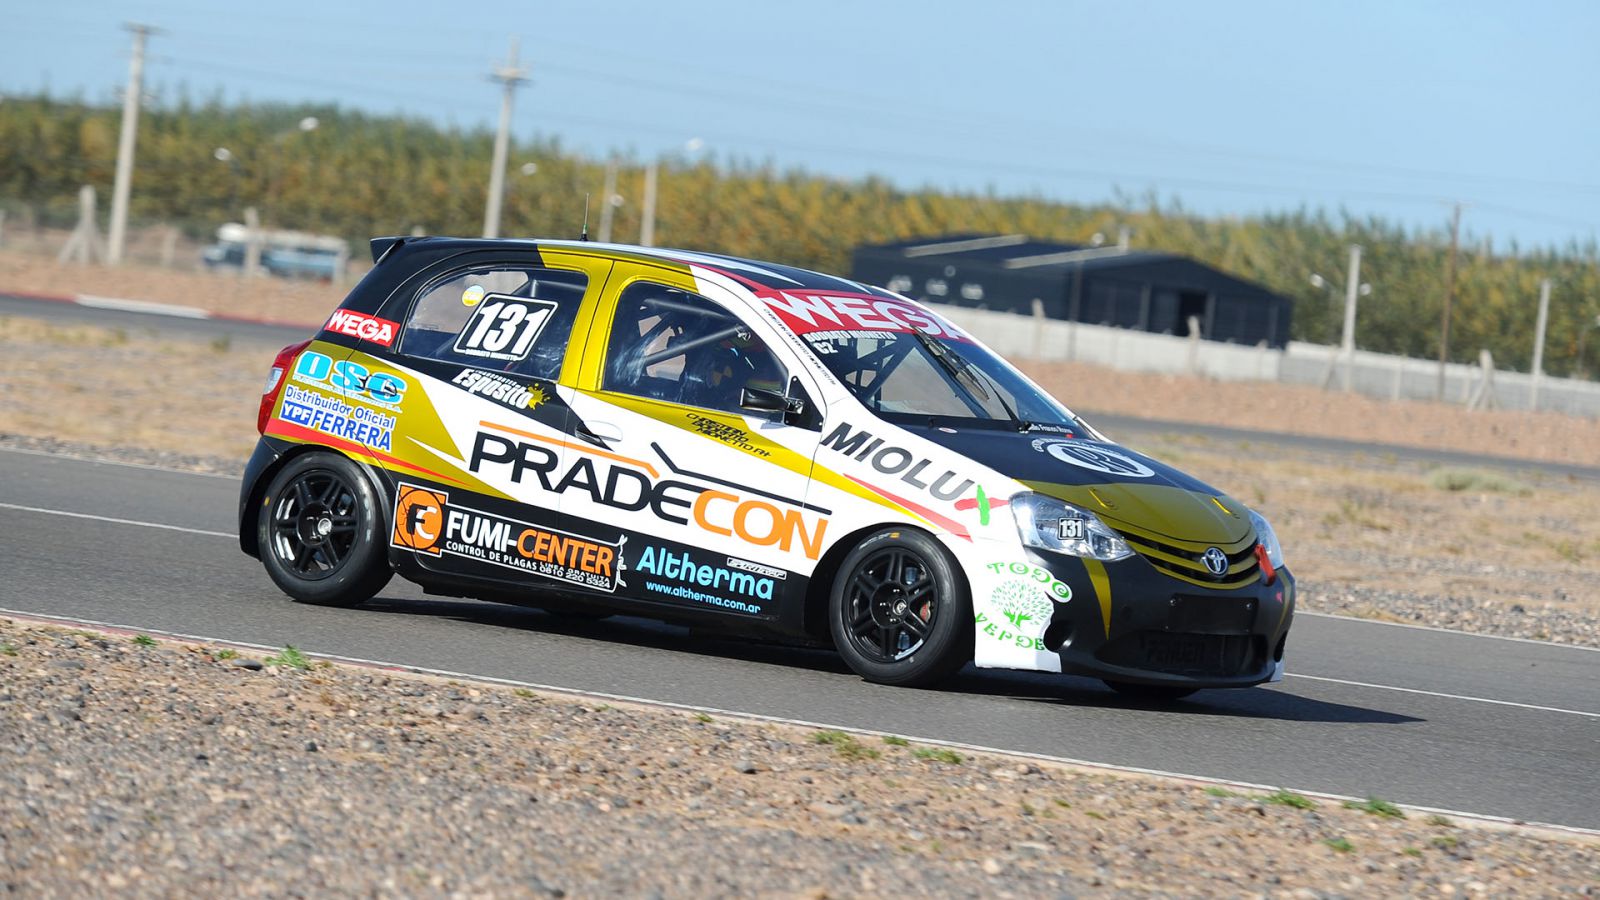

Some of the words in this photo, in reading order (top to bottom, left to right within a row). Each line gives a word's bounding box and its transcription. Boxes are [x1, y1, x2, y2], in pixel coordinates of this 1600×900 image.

[328, 309, 392, 343] WEGA
[466, 301, 550, 355] 131
[762, 290, 970, 339] WEGA
[813, 341, 839, 354] C2
[286, 386, 352, 416] Distribuidor
[355, 407, 395, 429] Oficial
[452, 368, 534, 409] Esposito
[283, 402, 311, 424] YPF
[311, 409, 391, 451] FERRERA
[469, 431, 828, 561] PRADECON
[446, 510, 613, 577] FUMI-CENTER
[1060, 520, 1082, 537] 131
[446, 541, 486, 558] CONTROL
[489, 552, 501, 561] DE
[503, 555, 537, 570] PLAGAS
[540, 561, 565, 572] LINEA
[567, 568, 610, 581] GRATUITA
[635, 546, 774, 600] Altherma
[539, 566, 564, 577] 0810
[565, 572, 584, 582] 220
[586, 577, 611, 588] 5324
[986, 562, 1070, 598] TODO
[646, 581, 761, 614] www.altherma.com.ar
